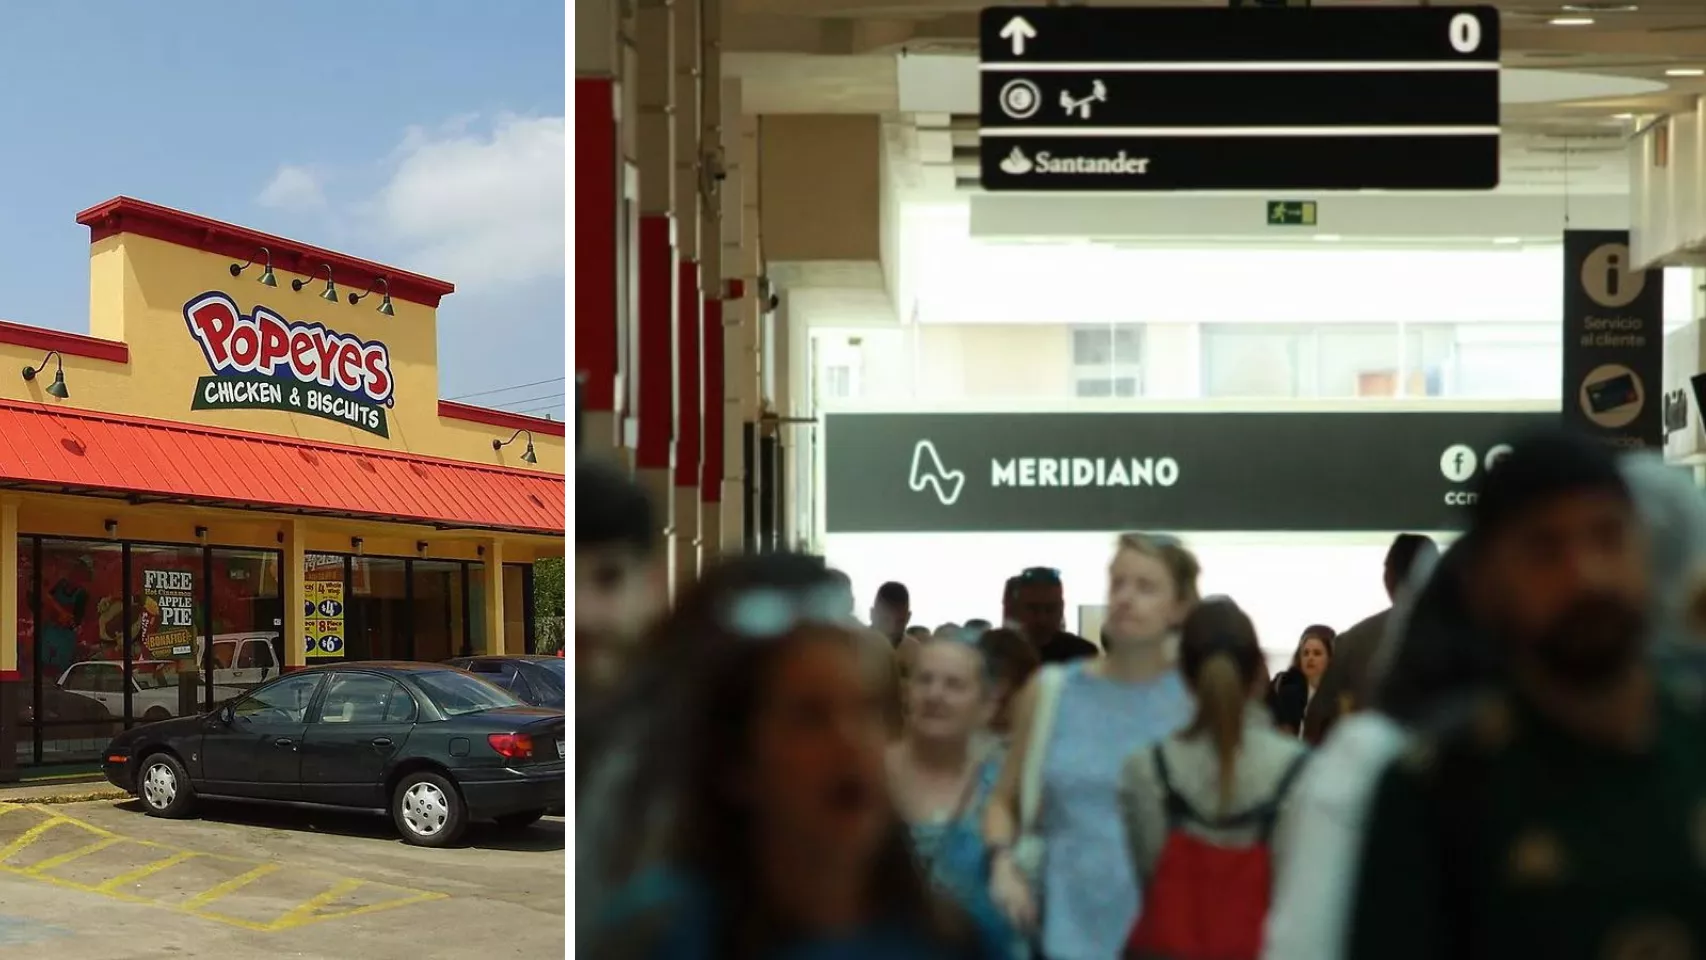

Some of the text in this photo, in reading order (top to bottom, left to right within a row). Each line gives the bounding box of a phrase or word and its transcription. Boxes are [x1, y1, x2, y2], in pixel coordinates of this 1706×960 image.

[1448, 12, 1481, 53] 0
[1034, 150, 1150, 174] Santander
[1583, 314, 1643, 330] Servicio
[192, 302, 388, 395] Popeyes
[204, 381, 379, 428] CHICKEN & BISCUITS
[991, 456, 1179, 487] MERIDIANO
[144, 569, 192, 591] FREE
[144, 588, 157, 596] Hot
[158, 596, 192, 608] APPLE
[161, 607, 192, 626] PIE
[319, 620, 326, 633] 8
